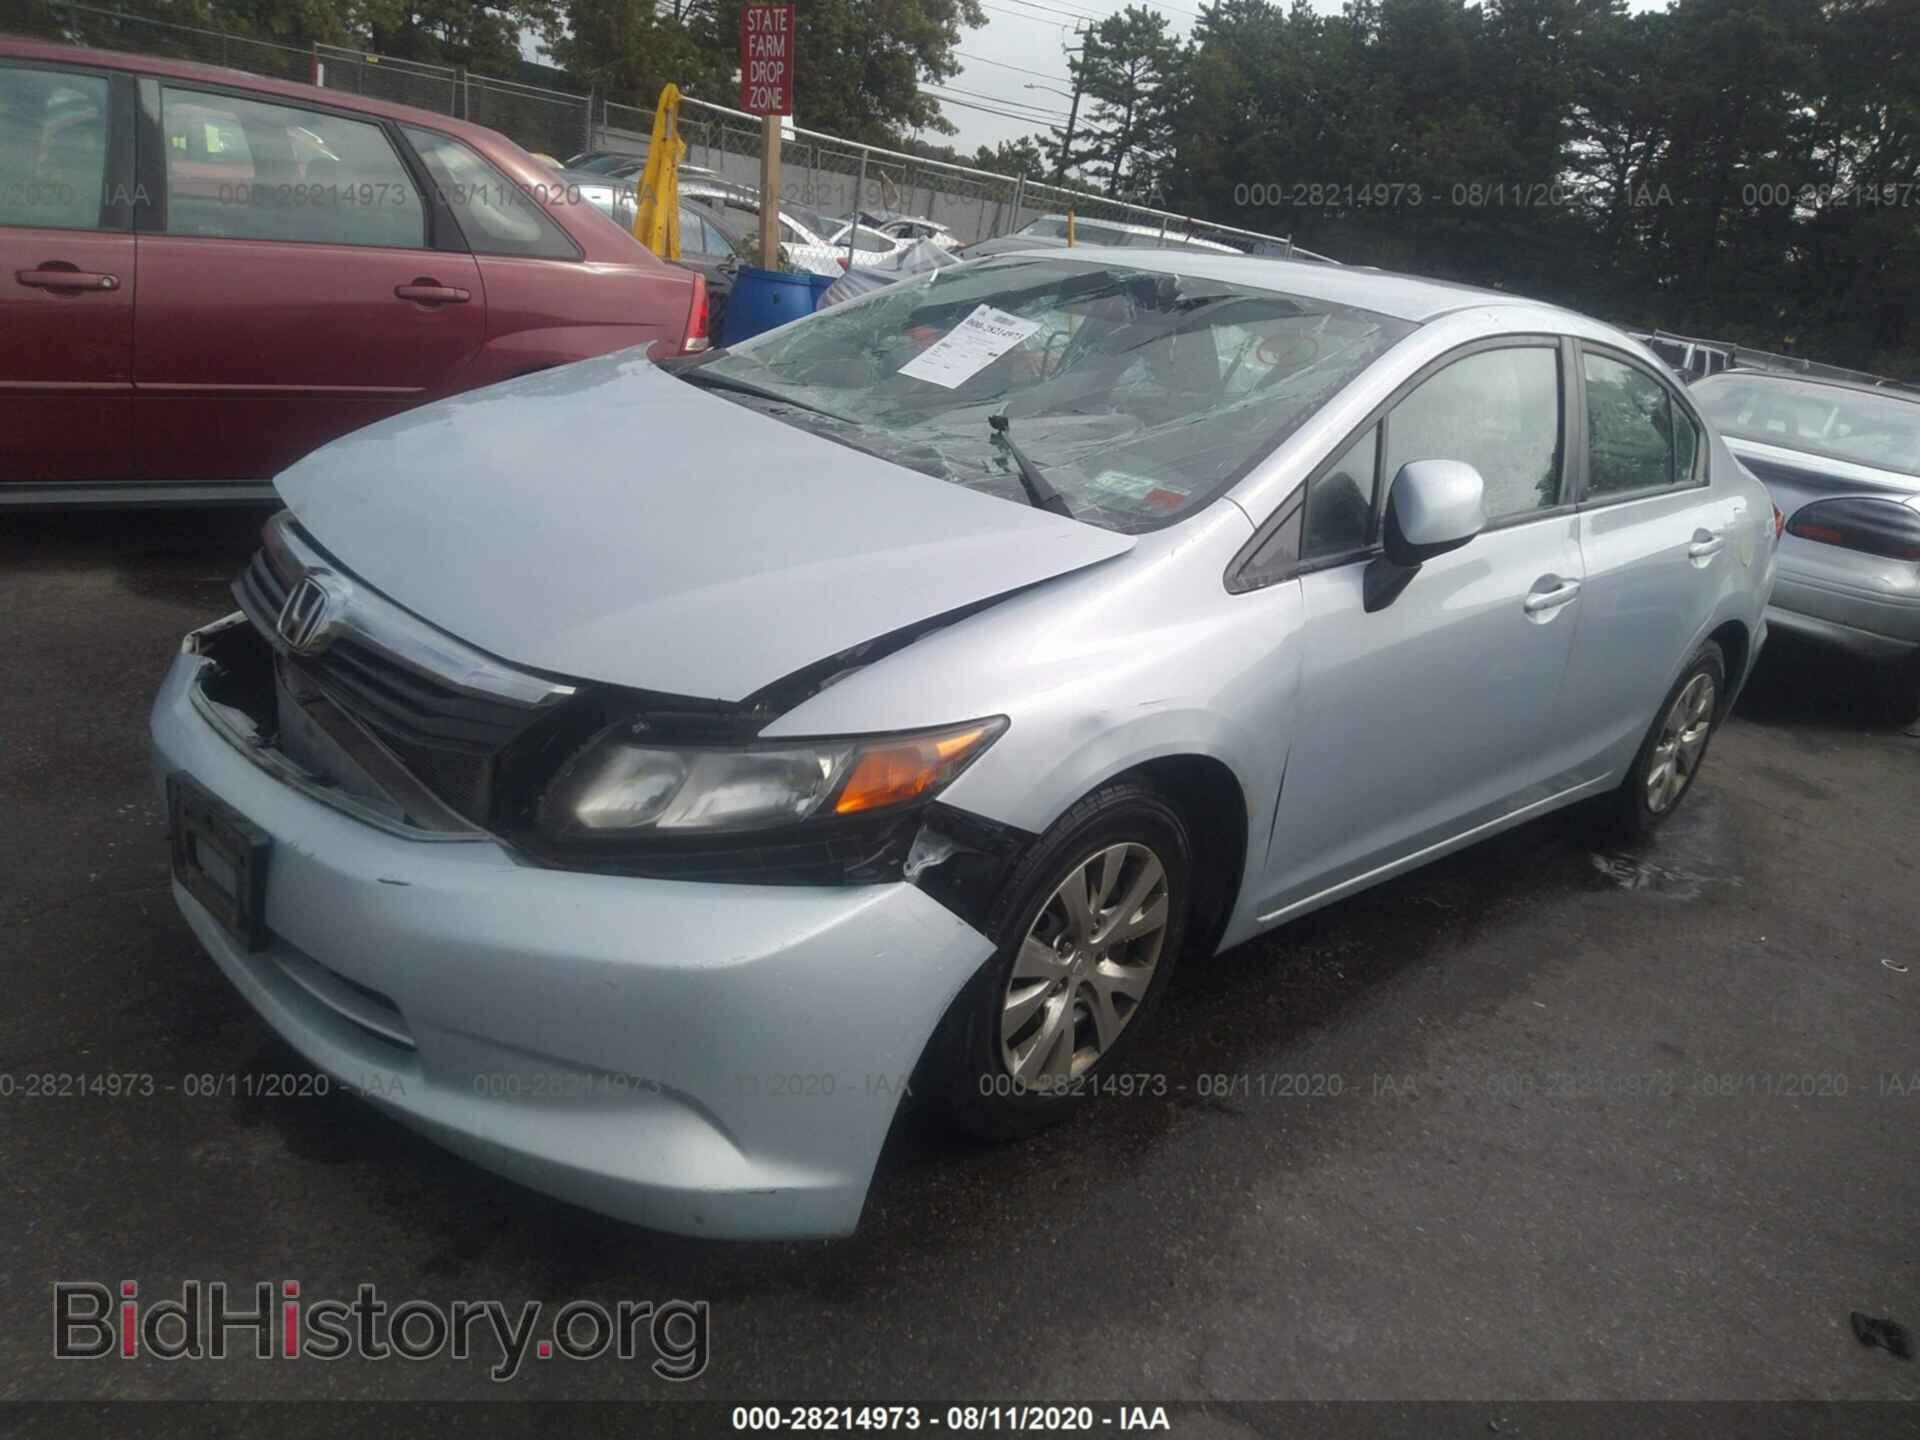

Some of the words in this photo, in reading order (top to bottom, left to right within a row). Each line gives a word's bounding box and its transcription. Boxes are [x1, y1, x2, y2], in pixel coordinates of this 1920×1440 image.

[747, 9, 787, 31] STATE
[749, 35, 785, 57] FARM
[750, 61, 785, 83] DROP
[749, 87, 783, 109] ZONE
